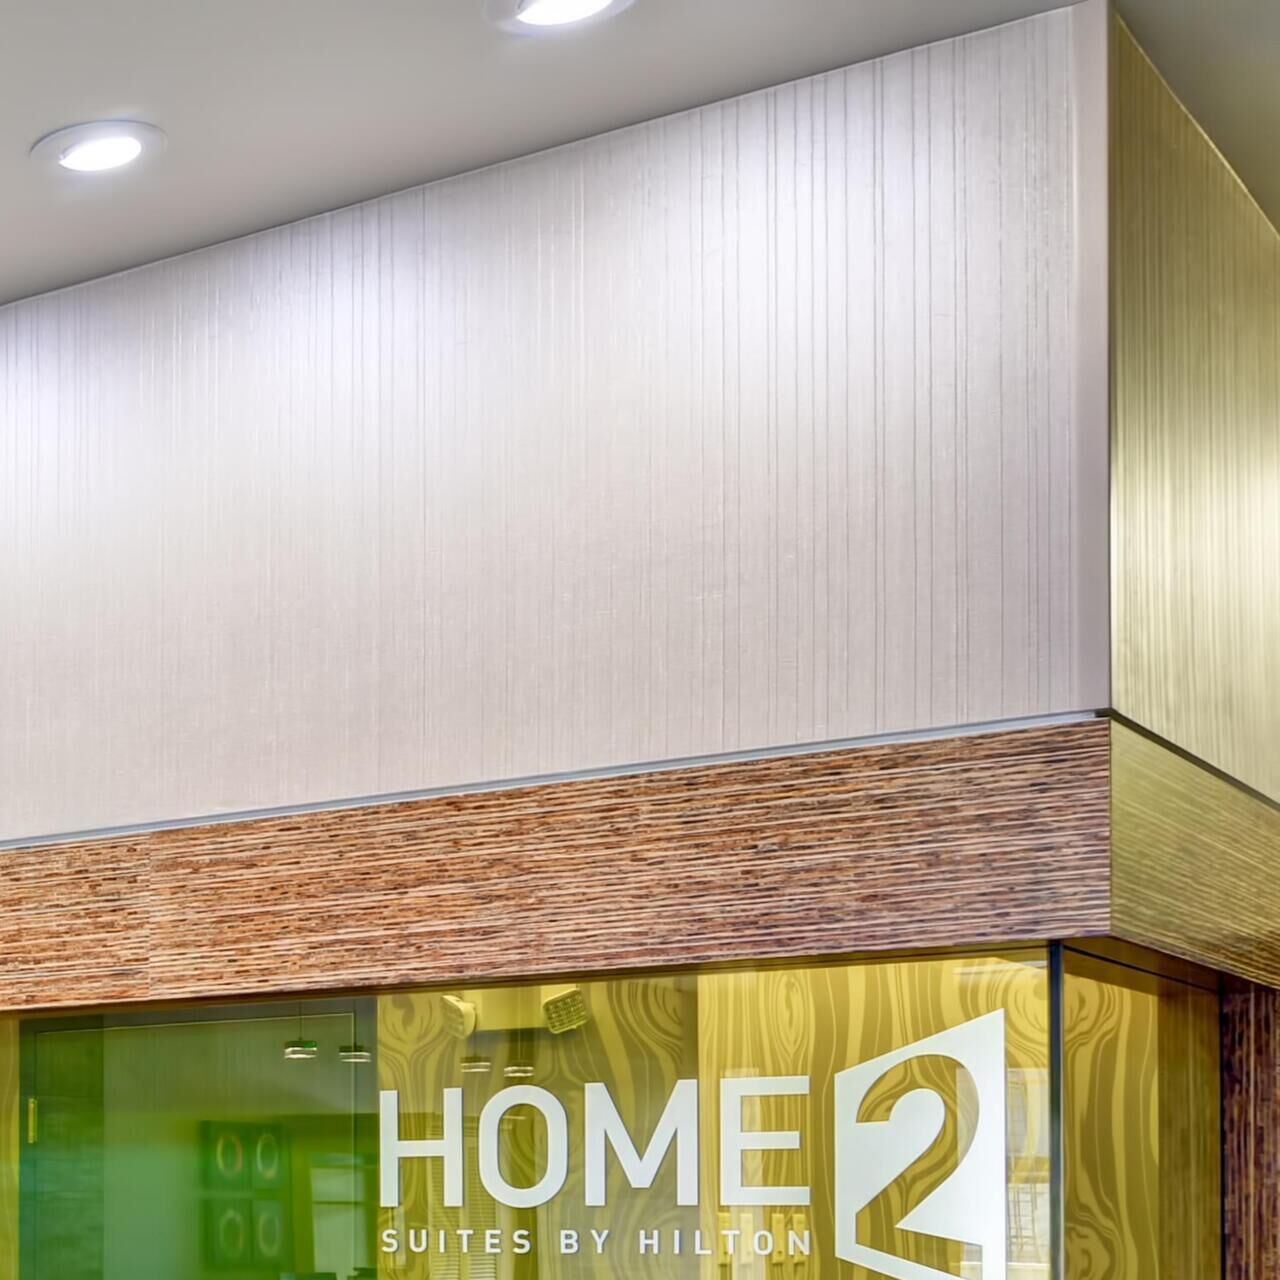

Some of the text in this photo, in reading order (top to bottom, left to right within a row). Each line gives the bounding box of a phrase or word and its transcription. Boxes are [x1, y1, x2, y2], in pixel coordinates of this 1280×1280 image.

[379, 1074, 811, 1208] HOME
[381, 1228, 811, 1257] SUITES BY HILTON
